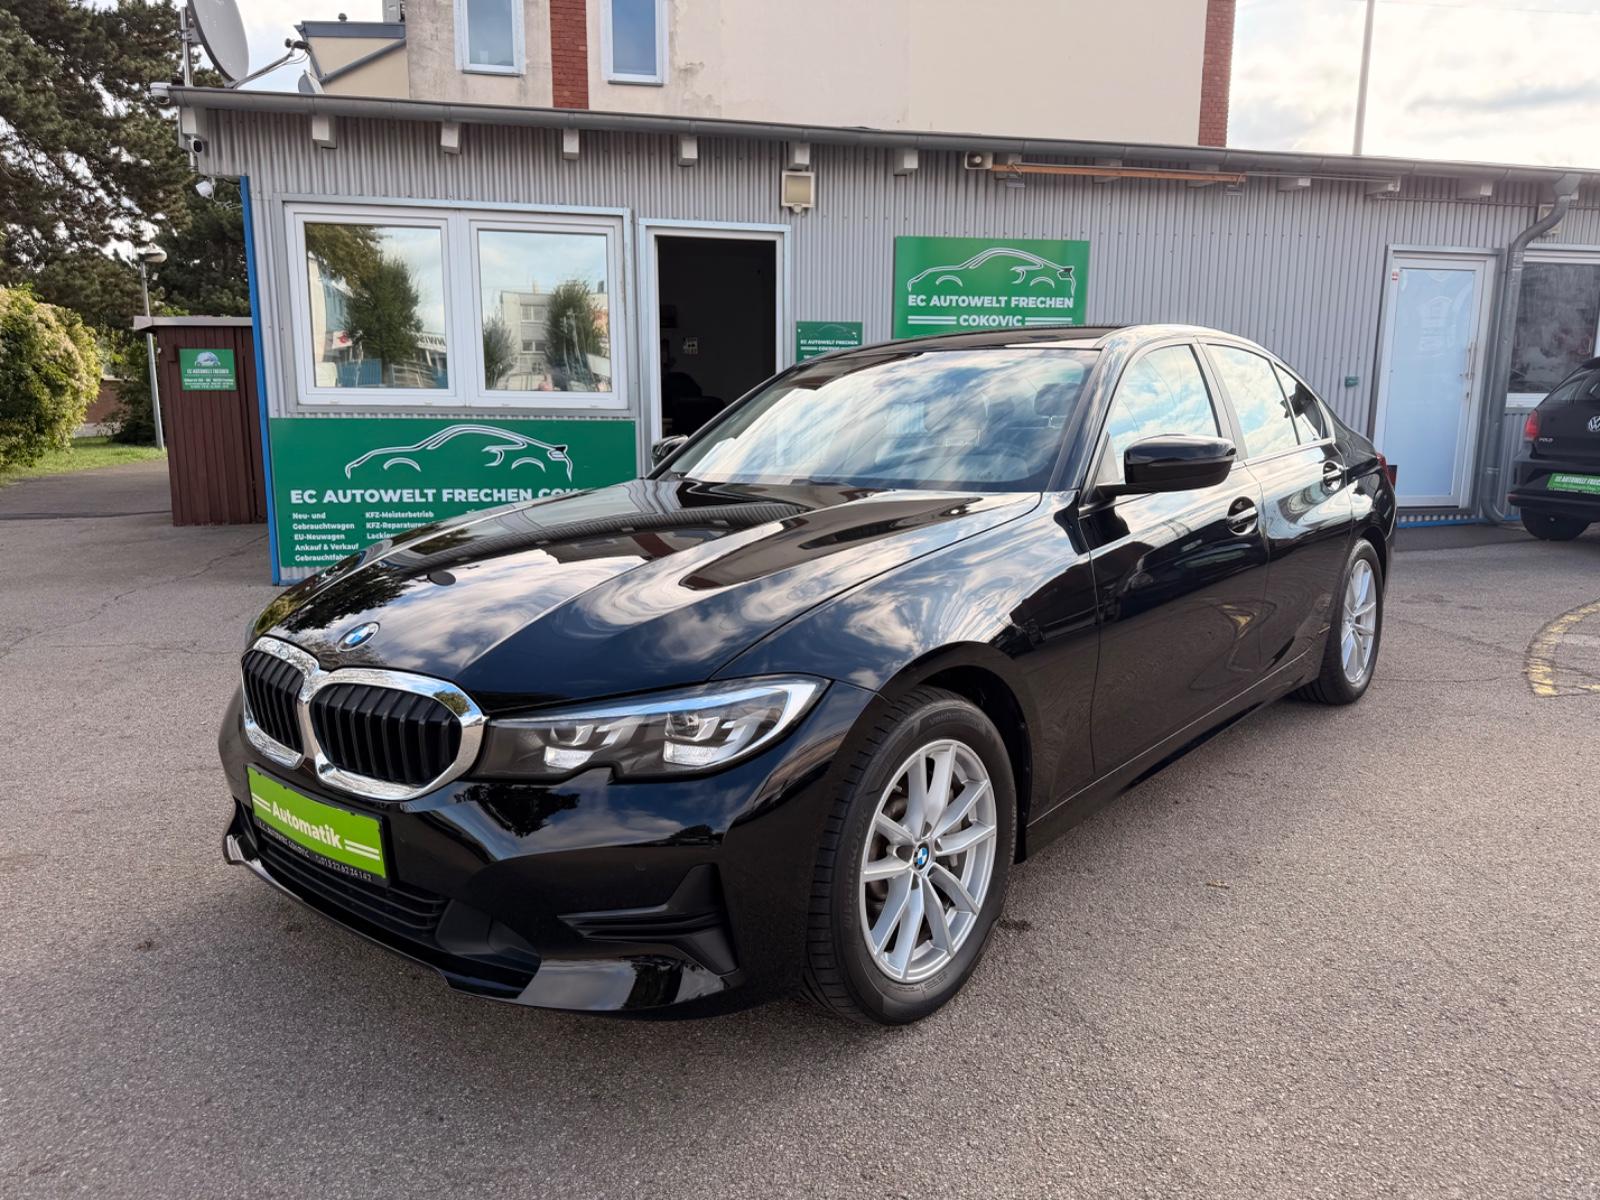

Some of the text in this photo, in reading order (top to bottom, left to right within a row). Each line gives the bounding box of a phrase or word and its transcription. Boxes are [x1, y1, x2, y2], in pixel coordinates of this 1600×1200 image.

[907, 294, 1075, 309] EC AUTOWELT FRECHEN
[959, 314, 1023, 327] COKOVIC
[290, 489, 317, 504] EC
[323, 488, 437, 504] AUTOWELT
[442, 488, 533, 502] FRECHEN
[292, 523, 355, 531] Gebrauchtwagen
[271, 801, 343, 850] Automatik
